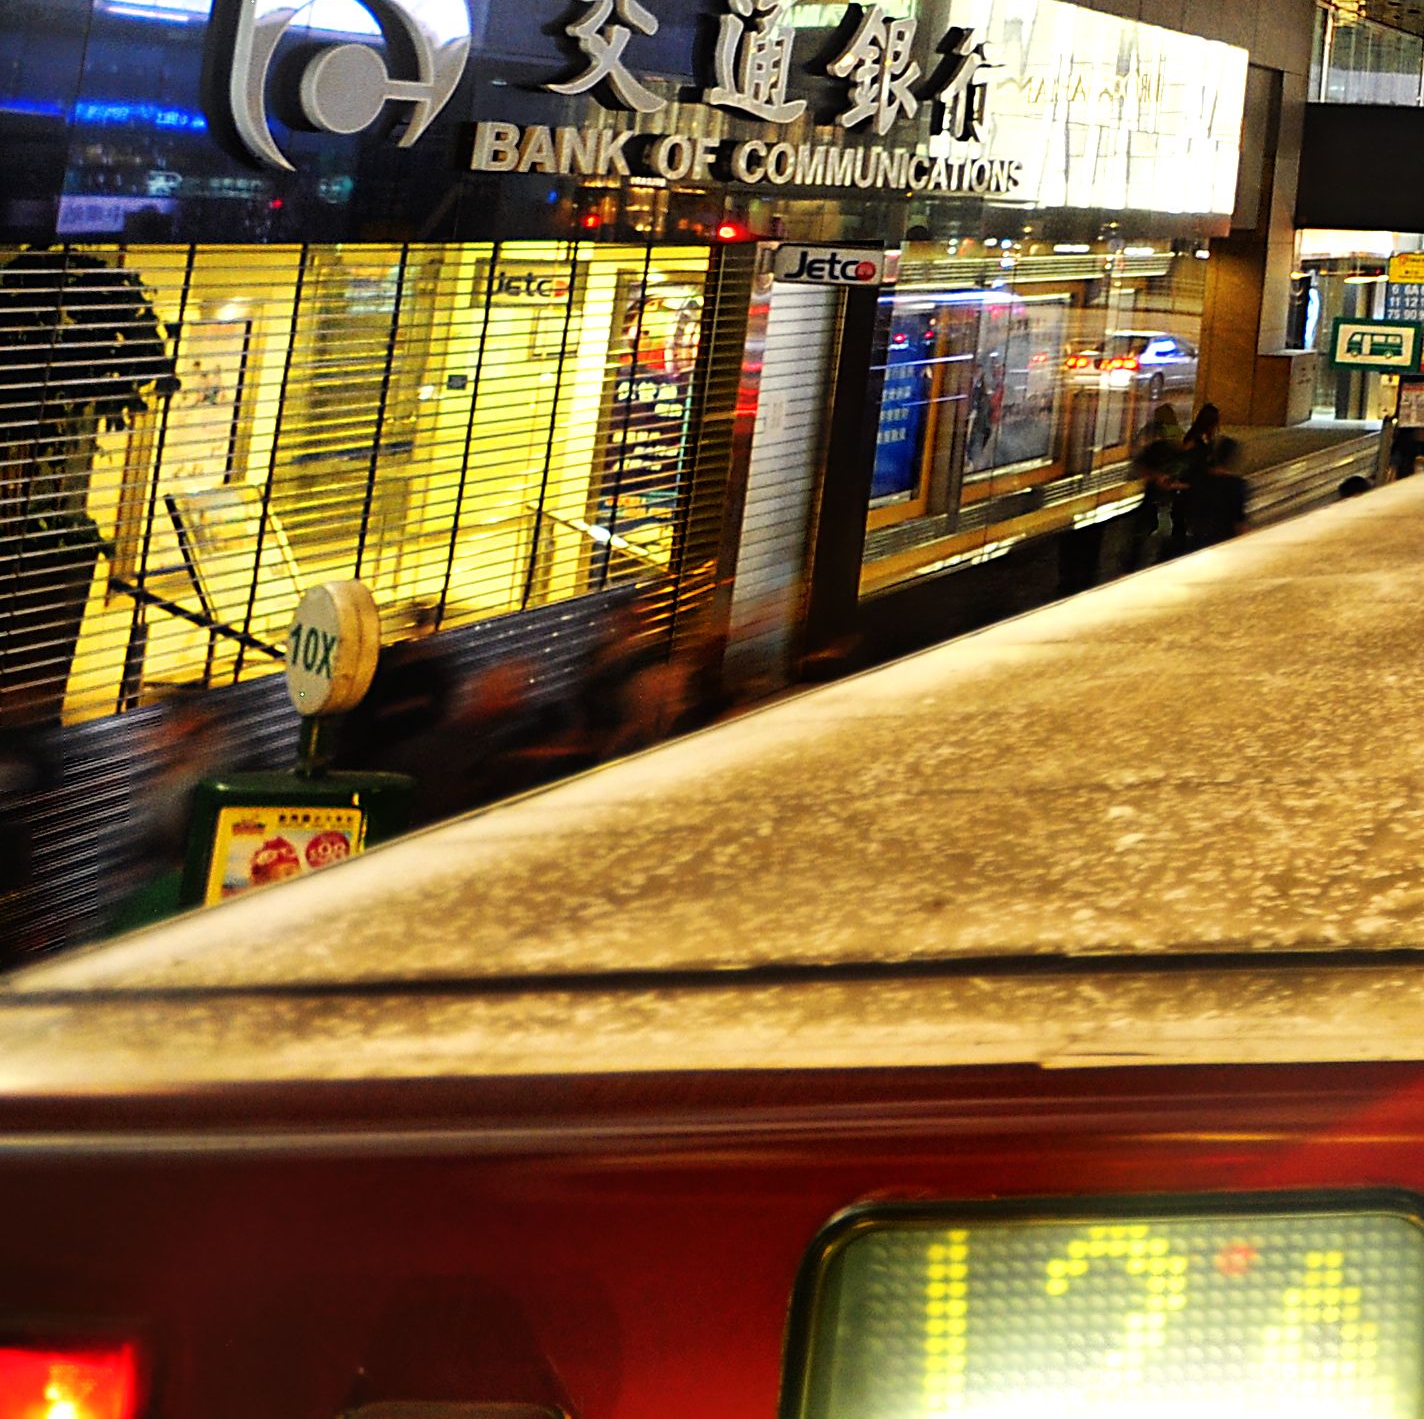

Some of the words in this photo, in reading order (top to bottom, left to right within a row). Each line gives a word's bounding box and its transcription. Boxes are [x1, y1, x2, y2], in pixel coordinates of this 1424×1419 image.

[470, 121, 633, 175] BANK
[657, 135, 719, 180] OF
[731, 140, 1024, 192] COMMUNICATIONS
[291, 622, 337, 679] 10X
